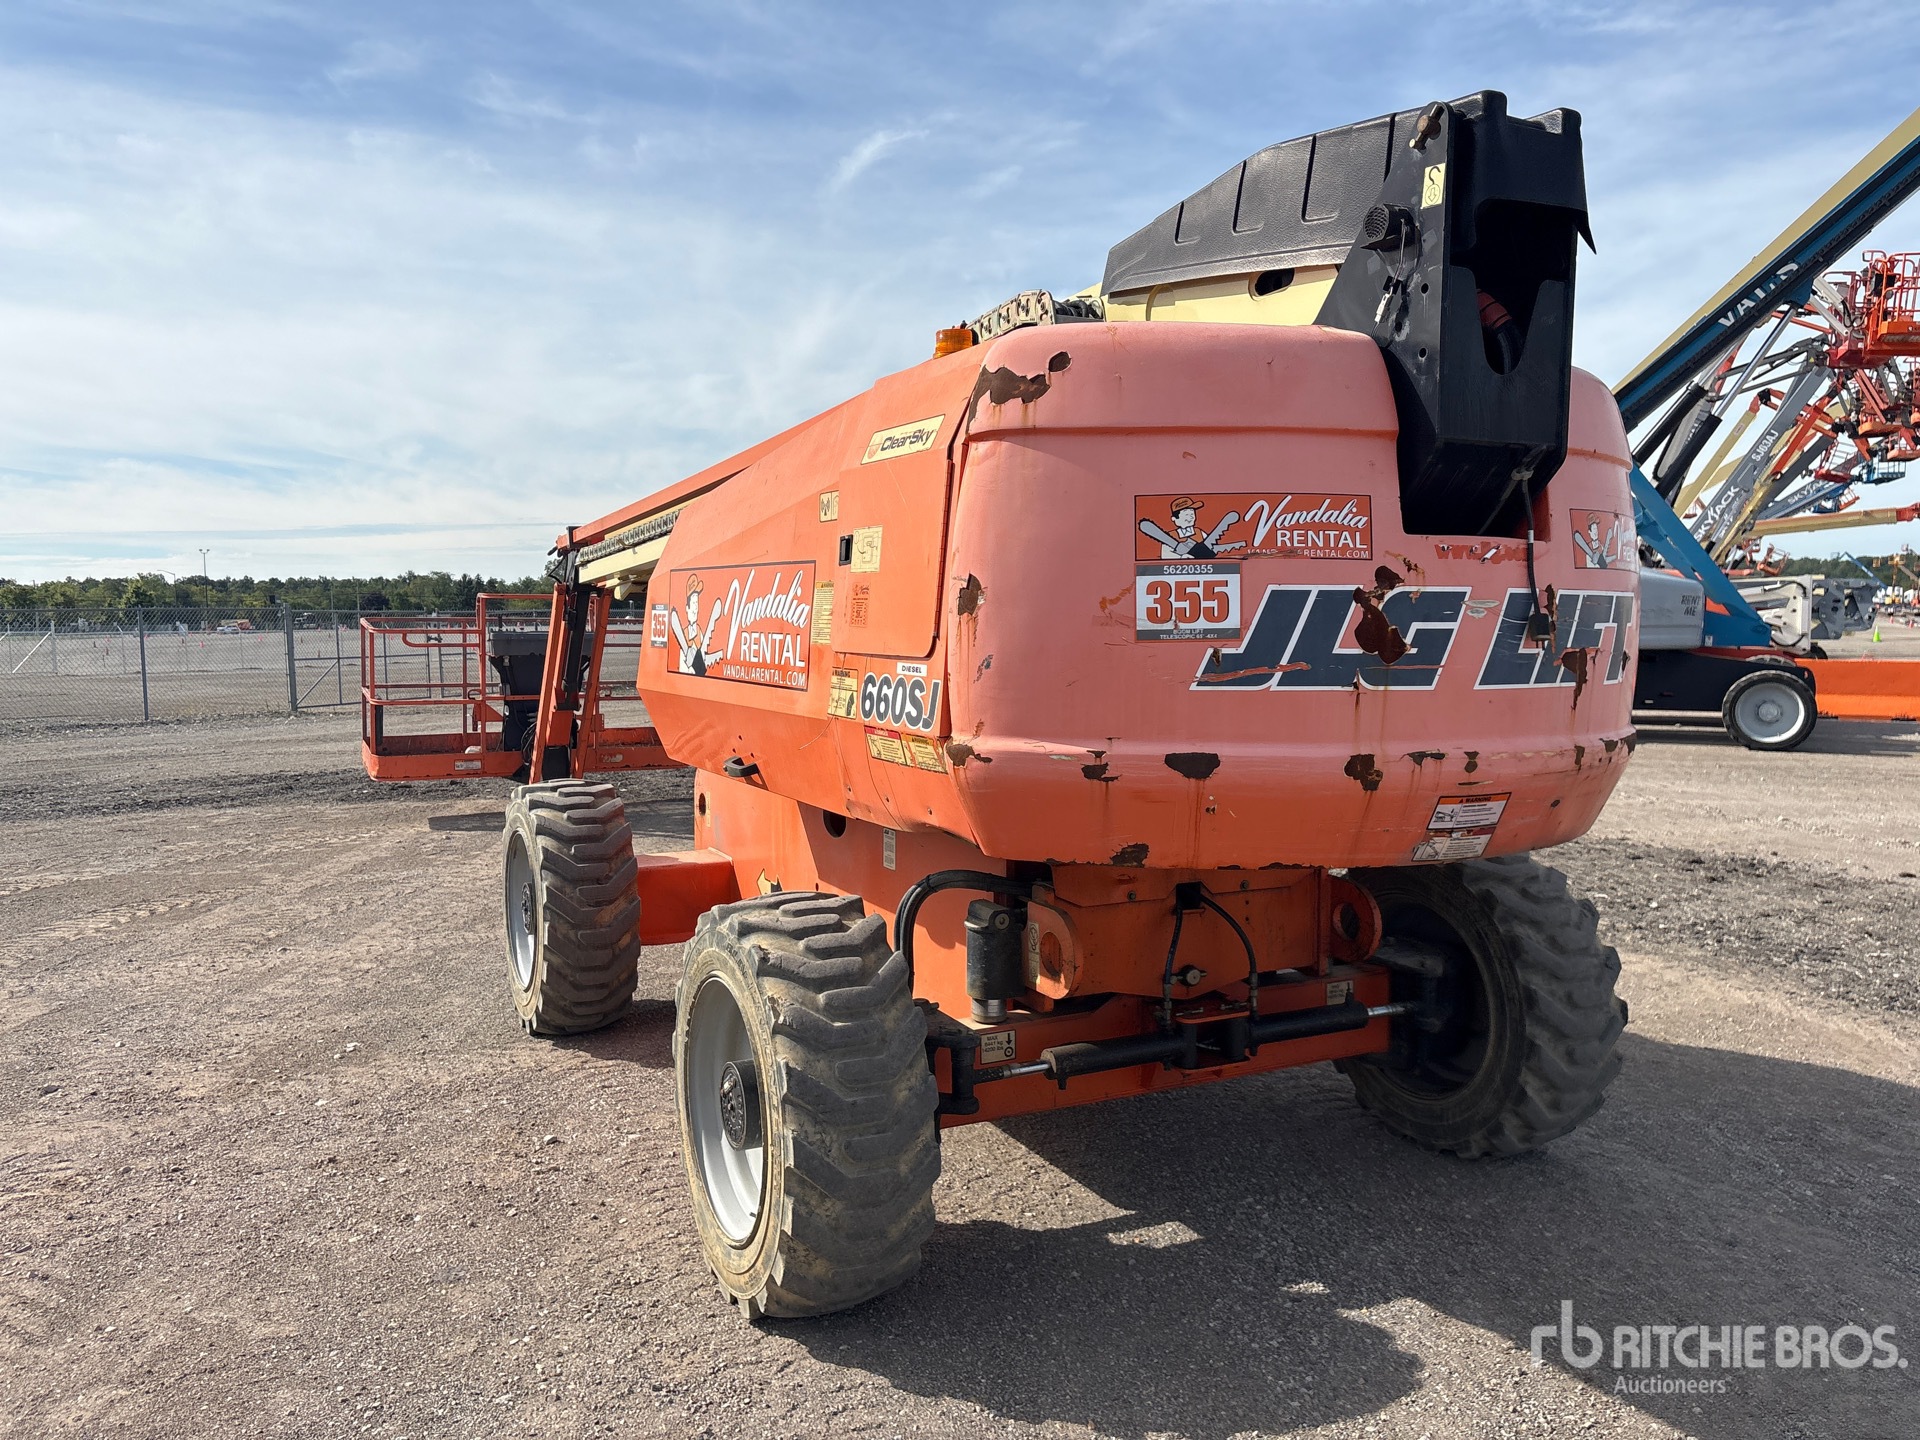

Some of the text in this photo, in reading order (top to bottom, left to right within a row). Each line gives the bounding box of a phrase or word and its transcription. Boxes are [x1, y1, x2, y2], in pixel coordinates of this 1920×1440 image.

[881, 428, 934, 451] ClearSky
[1244, 495, 1368, 547] Vandalia
[1694, 486, 1740, 542] SKYJACK
[1276, 530, 1368, 548] RENTAL
[1163, 565, 1213, 574] 56220355
[724, 568, 810, 660] Vandalia
[1146, 580, 1230, 624] 355
[653, 613, 667, 639] 355
[1189, 584, 1473, 691] JLG
[740, 630, 806, 668] RENTAL
[723, 664, 806, 686] VANDALIARENTAL.COM
[901, 665, 922, 674] DIESEL
[860, 672, 941, 732] 660SJ
